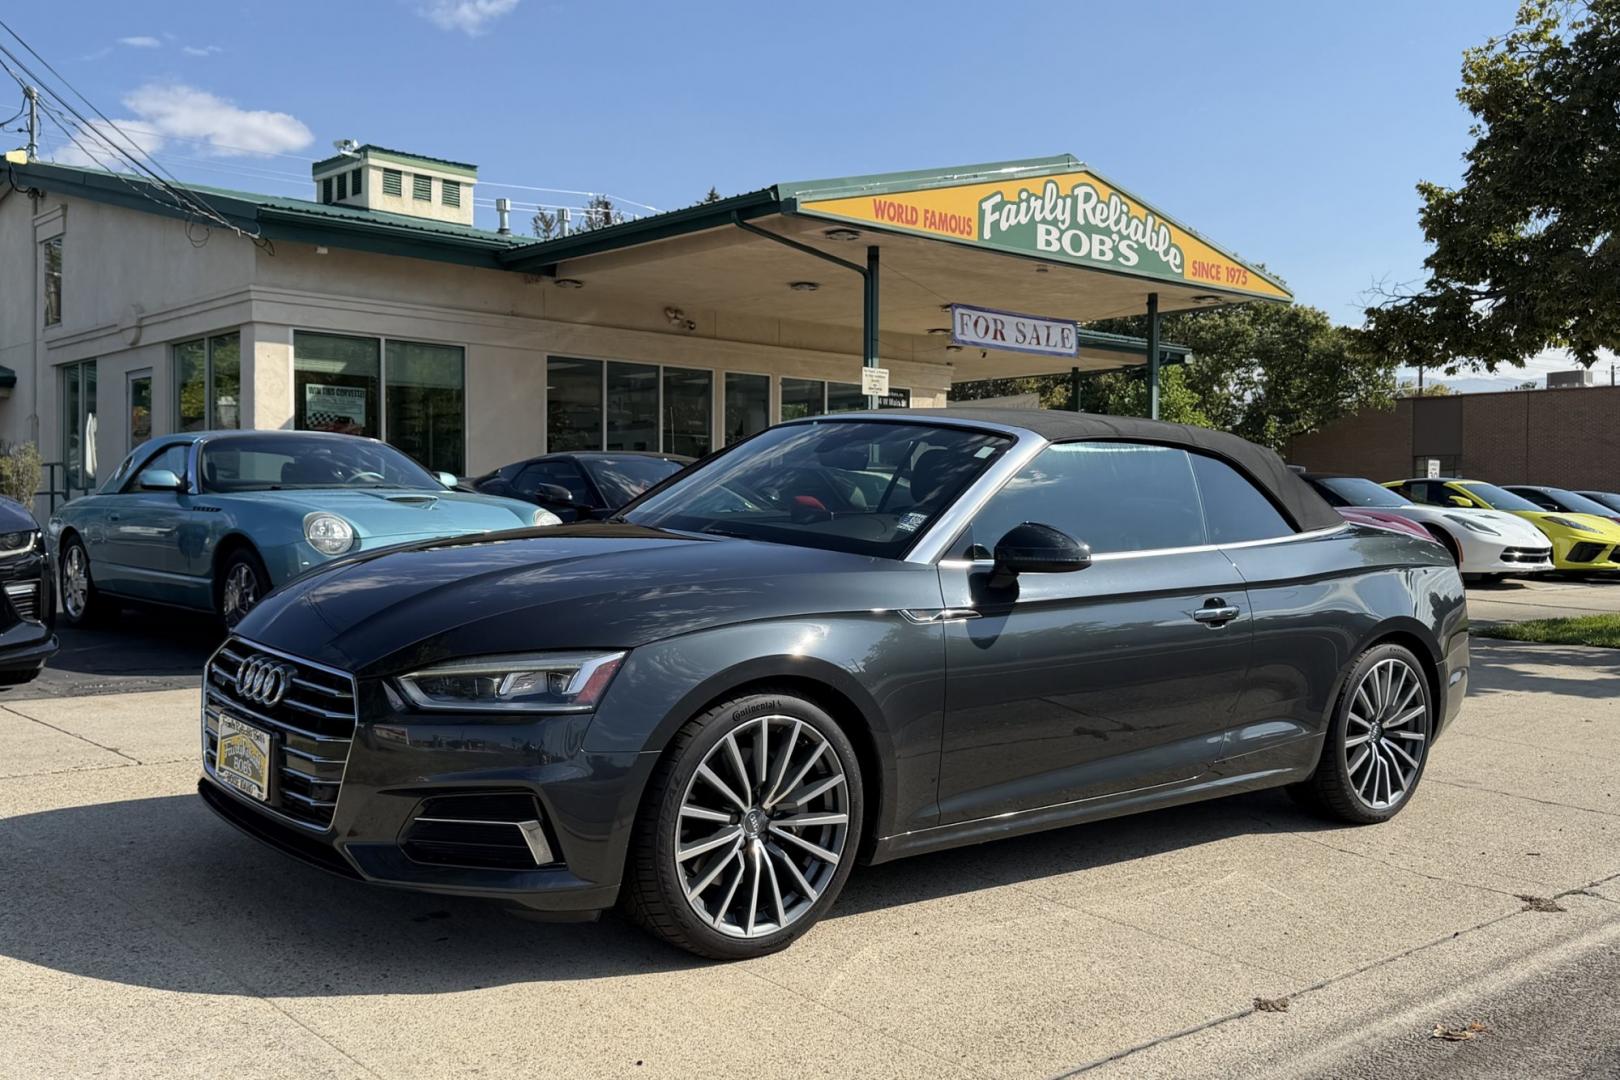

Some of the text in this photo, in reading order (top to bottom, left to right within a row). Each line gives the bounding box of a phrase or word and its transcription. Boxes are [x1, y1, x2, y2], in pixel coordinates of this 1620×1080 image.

[873, 198, 973, 236] WORLD FAMOUS
[981, 182, 1182, 273] Fairly Reliable
[1036, 223, 1139, 267] BOB'S
[1192, 260, 1248, 285] SINCE 1975
[958, 312, 1074, 350] FOR SALE
[732, 700, 775, 721] Continental
